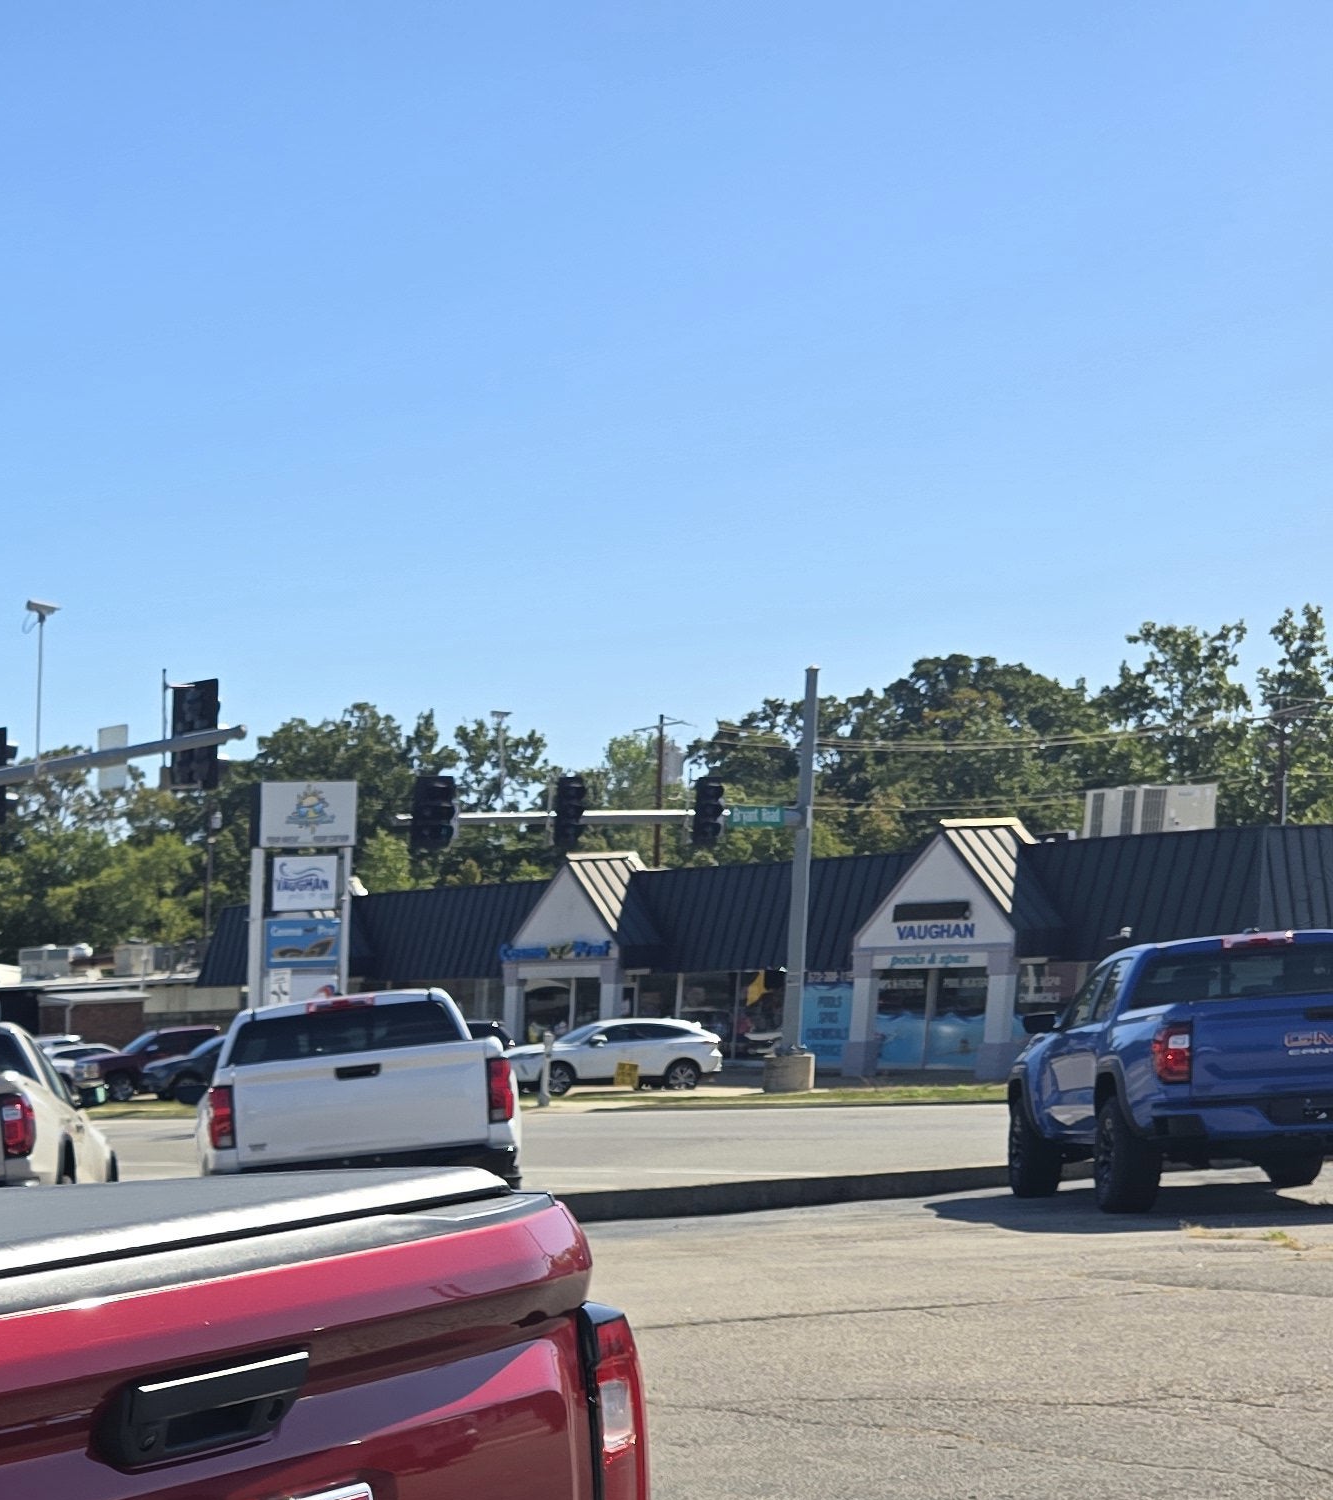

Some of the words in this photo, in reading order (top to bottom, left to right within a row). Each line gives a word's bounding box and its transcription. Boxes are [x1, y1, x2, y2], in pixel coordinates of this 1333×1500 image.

[733, 807, 758, 825] Bryant
[761, 808, 780, 822] Road
[276, 877, 330, 892] VAUGHAN
[897, 922, 975, 940] VAUGHAN
